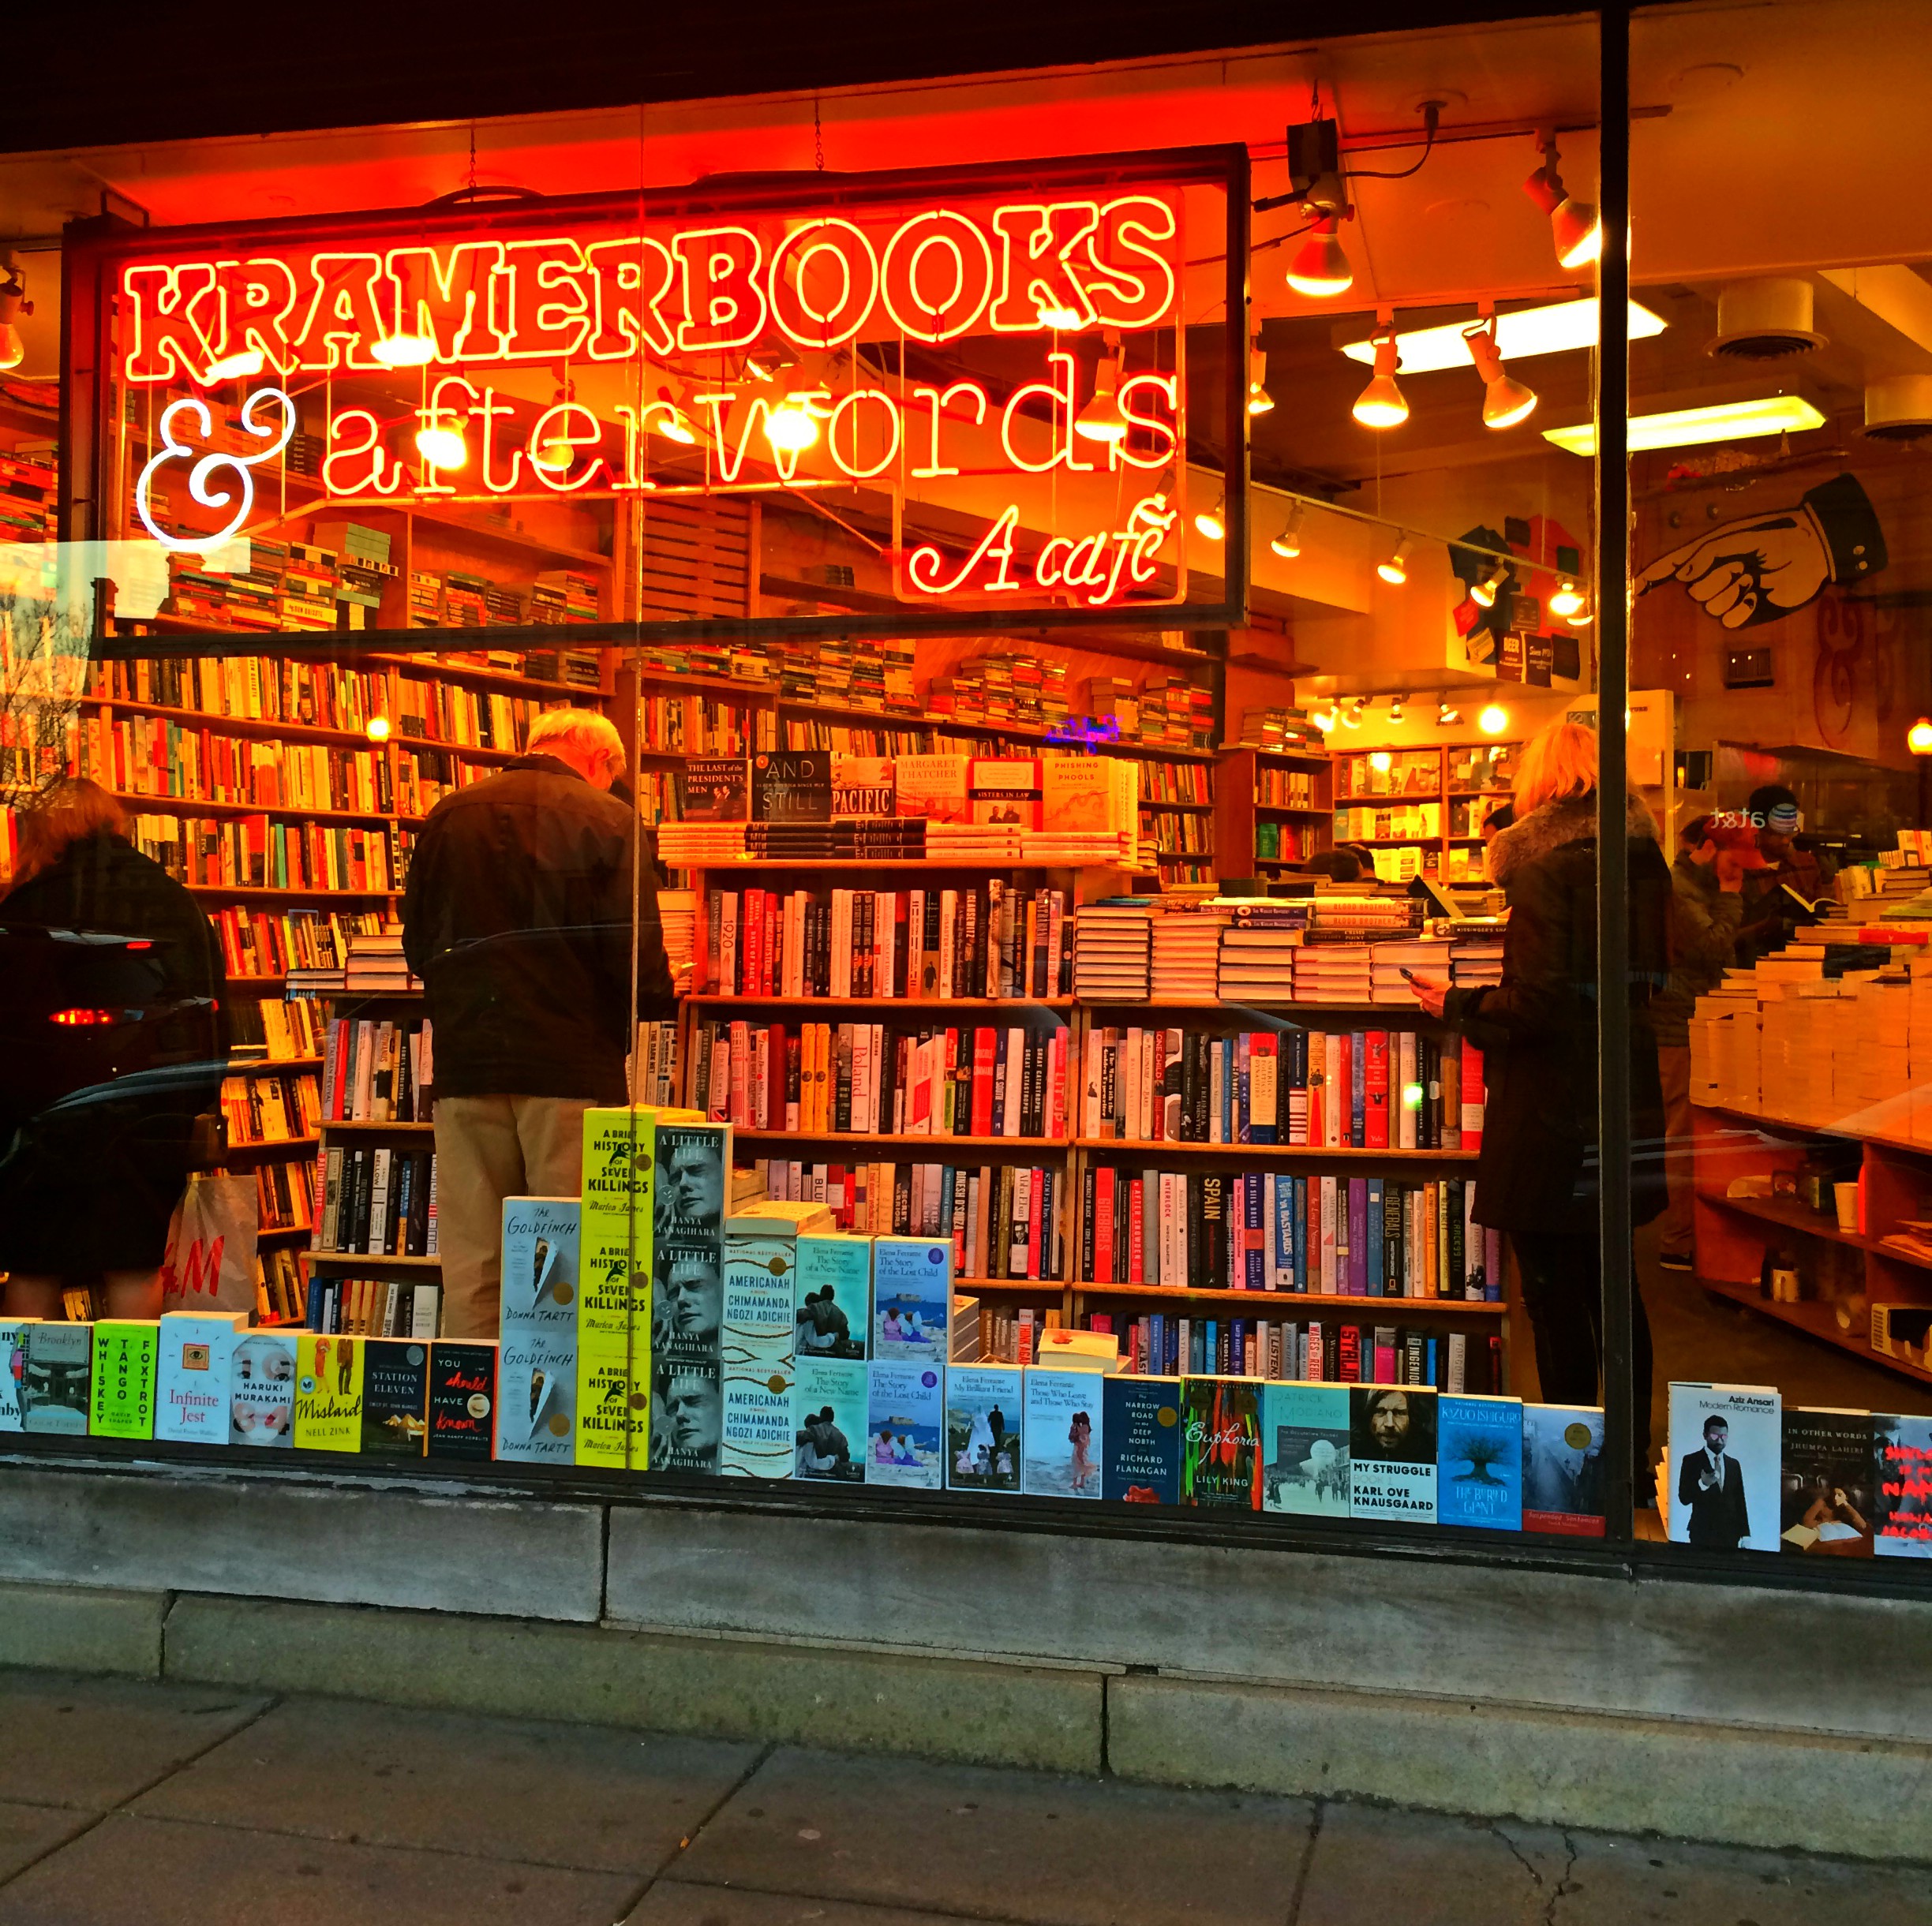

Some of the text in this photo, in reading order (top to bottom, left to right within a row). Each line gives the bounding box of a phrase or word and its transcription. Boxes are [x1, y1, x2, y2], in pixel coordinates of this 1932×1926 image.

[124, 195, 1176, 384] KRAMERBOOKS
[136, 353, 1180, 553] & afterwords
[908, 496, 1176, 606] A café
[766, 761, 814, 779] AND
[900, 759, 957, 769] MARGARET
[687, 774, 743, 783] PRESIDENT'S
[900, 770, 957, 779] THATCHER
[762, 792, 818, 810] STILL
[832, 789, 889, 813] PACIFIC
[966, 895, 976, 938] CLAUSEWITZ
[723, 919, 735, 948] 1920
[852, 1046, 868, 1098] Poland
[994, 1063, 1005, 1101] THINK SOUTH
[1022, 1071, 1031, 1114] CATASTROPHE
[1053, 1071, 1065, 1122] LIT UP
[671, 1135, 719, 1148] LITTLE
[674, 1147, 703, 1161] LIFE
[588, 1179, 649, 1194] KILLINGS
[953, 1171, 966, 1230] DINESH D'SOUZA
[1017, 1174, 1028, 1217] Abba Eban
[1204, 1177, 1221, 1220] SPAIN
[589, 1200, 616, 1212] Marlon
[671, 1217, 702, 1225] HANYA
[1097, 1198, 1111, 1251] GOEBBELS
[1133, 1190, 1142, 1260] AFTER SNOWDEN
[1384, 1196, 1401, 1239] GENERALS
[507, 1216, 578, 1236] GOLDFINCH
[657, 1225, 715, 1236] YANAGIHARA
[1280, 1210, 1294, 1255] BASTARDS
[668, 1251, 717, 1264] LITTLE
[812, 1247, 829, 1255] Elena
[831, 1256, 851, 1267] Story
[672, 1263, 702, 1276] LIFE
[819, 1265, 860, 1275] New Name
[901, 1267, 939, 1277] Lost Child
[728, 1275, 790, 1290] AMERICANAH
[584, 1296, 646, 1311] KILLINGS
[728, 1295, 790, 1309] CHIMAMANDA
[505, 1308, 575, 1322] DONNA TARTT
[726, 1308, 792, 1323] NGOZI ADICHIE
[39, 1331, 82, 1346] Brooklyn
[669, 1331, 700, 1341] HANYA
[1019, 1323, 1032, 1345] THINK
[1309, 1326, 1320, 1351] WAGES
[654, 1341, 714, 1353] YANAGIHARA
[438, 1359, 461, 1368] YOU
[503, 1345, 574, 1367] GOLDFINCH
[117, 1339, 129, 1401] TANGO
[667, 1364, 717, 1380] LITTLE
[1454, 1343, 1463, 1393] FORGOTTEN
[96, 1337, 110, 1424] WHISKEY
[138, 1341, 151, 1427] FOXTROT
[372, 1371, 418, 1382] STATION
[445, 1371, 491, 1393] should
[243, 1382, 283, 1392] HARUKI
[374, 1384, 415, 1395] ELEVEN
[840, 1387, 860, 1397] Name
[953, 1383, 1013, 1394] My Brilliant Friend
[1030, 1388, 1088, 1400] Those Who Leave
[169, 1389, 219, 1407] Infinite
[234, 1393, 291, 1404] MURAKAMI
[434, 1396, 464, 1406] HAVE
[728, 1392, 789, 1408] AMERICANAH
[894, 1390, 932, 1401] Lost Child
[1030, 1397, 1094, 1409] and Who Stay
[1272, 1391, 1324, 1404] PATRICK
[1728, 1395, 1775, 1407] Aziz Ansari
[295, 1395, 363, 1420] Mislaid
[1125, 1401, 1160, 1410] NARROW
[1699, 1400, 1775, 1415] Modern Romance
[179, 1407, 206, 1425] Jest
[436, 1409, 482, 1433] known
[727, 1412, 789, 1427] CHIMAMANDA
[1279, 1406, 1342, 1421] MODIANO
[1441, 1405, 1522, 1423] KAZUO ISHIGURO
[305, 1427, 351, 1437] NELL ZINK
[582, 1418, 644, 1433] KILLINGS
[1133, 1427, 1151, 1436] DEEP
[725, 1426, 791, 1442] NGOZI ADICHIE
[1128, 1437, 1156, 1446] NORTH
[1801, 1429, 1868, 1441] OTHER WORDS
[501, 1437, 571, 1454] DONNA TARTT
[1185, 1421, 1260, 1465] Euphoria
[1789, 1442, 1864, 1455] JHUMPA LAHIRI
[653, 1457, 713, 1470] YANAGIHARA
[1120, 1453, 1163, 1464] RICHARD
[1115, 1464, 1167, 1476] FLANAGAN
[1353, 1462, 1432, 1478] MY STRUGGLE
[1196, 1475, 1249, 1487] LILY KING
[1353, 1485, 1410, 1498] KARL OVE
[1473, 1487, 1508, 1503] BURIED
[1353, 1496, 1434, 1511] KNAUSGAARD
[1463, 1501, 1496, 1515] GIANT
[1527, 1510, 1563, 1520] Suspended
[1565, 1513, 1601, 1524] Sentences
